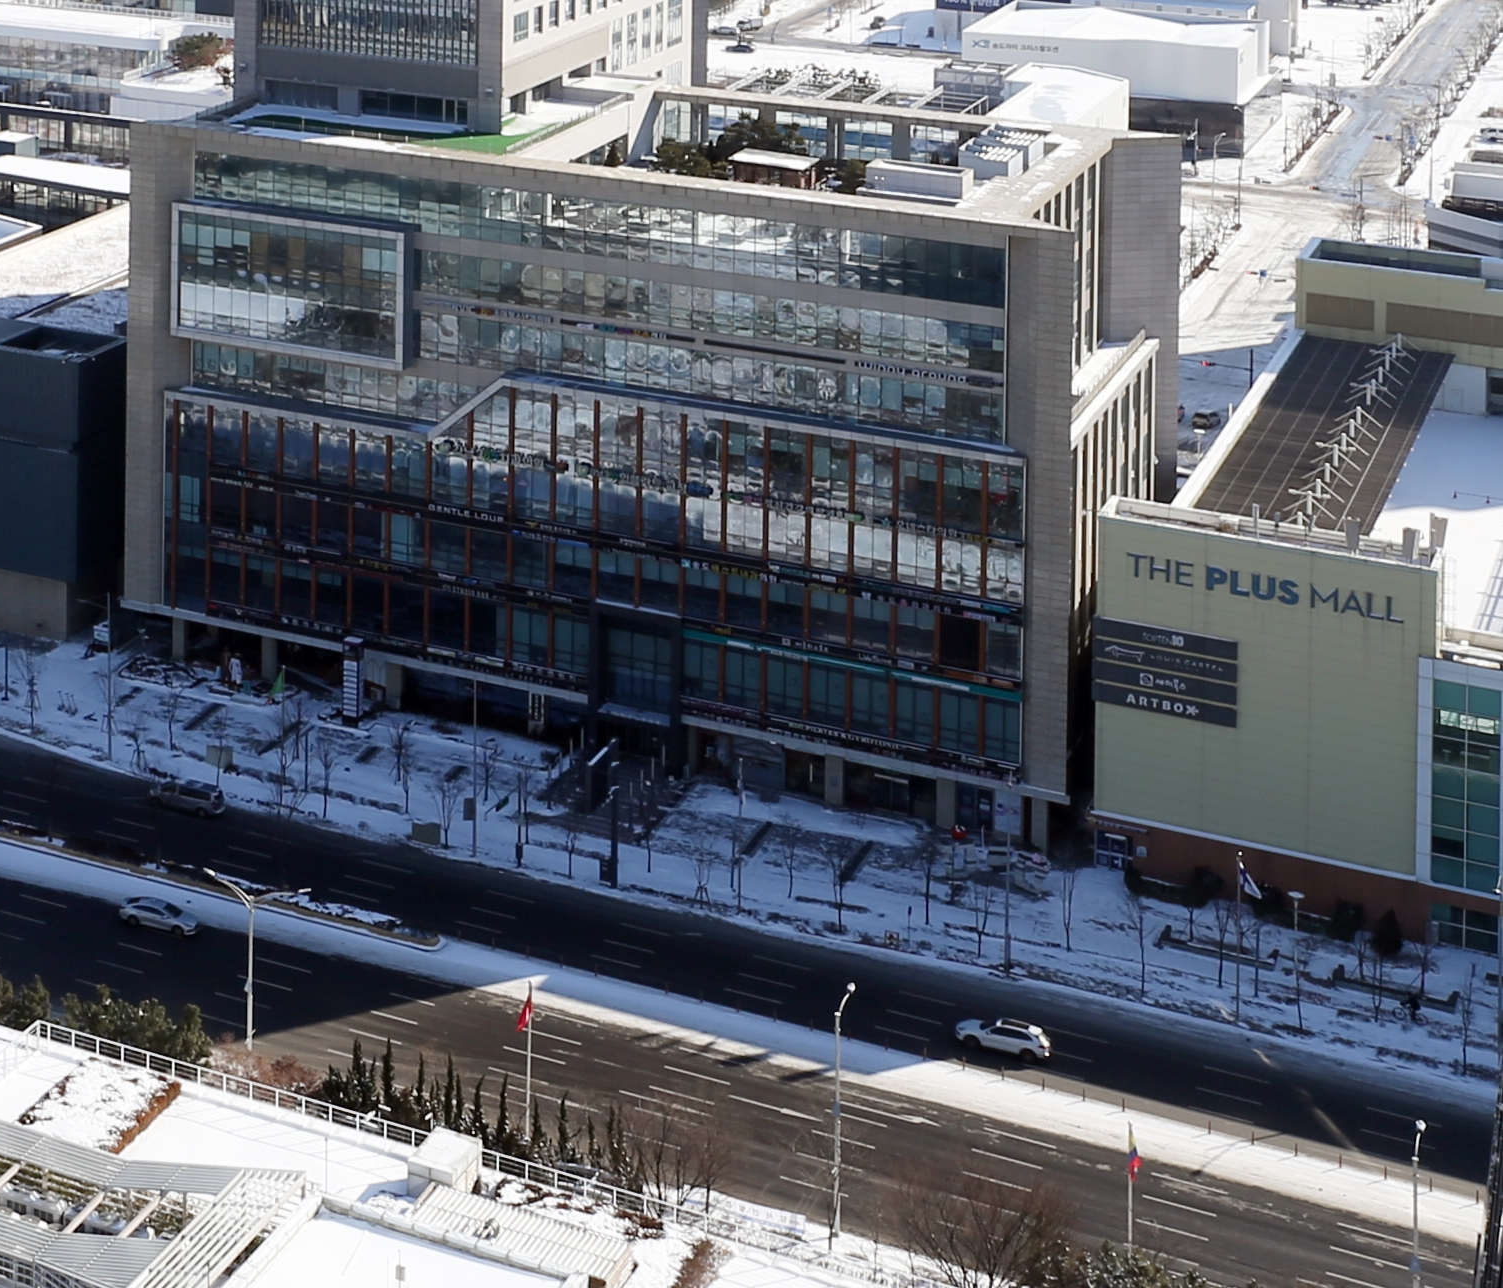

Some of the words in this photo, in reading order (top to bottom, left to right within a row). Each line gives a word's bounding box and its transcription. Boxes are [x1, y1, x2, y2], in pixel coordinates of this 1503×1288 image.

[912, 369, 967, 384] ground
[428, 503, 471, 519] GENTLE
[1126, 551, 1194, 588] THE
[1205, 565, 1300, 606] PLUS
[1309, 582, 1405, 625] MALL
[1150, 654, 1181, 665] LOUIS
[1184, 659, 1224, 673] CASTEL
[1125, 693, 1200, 717] ARTBOX
